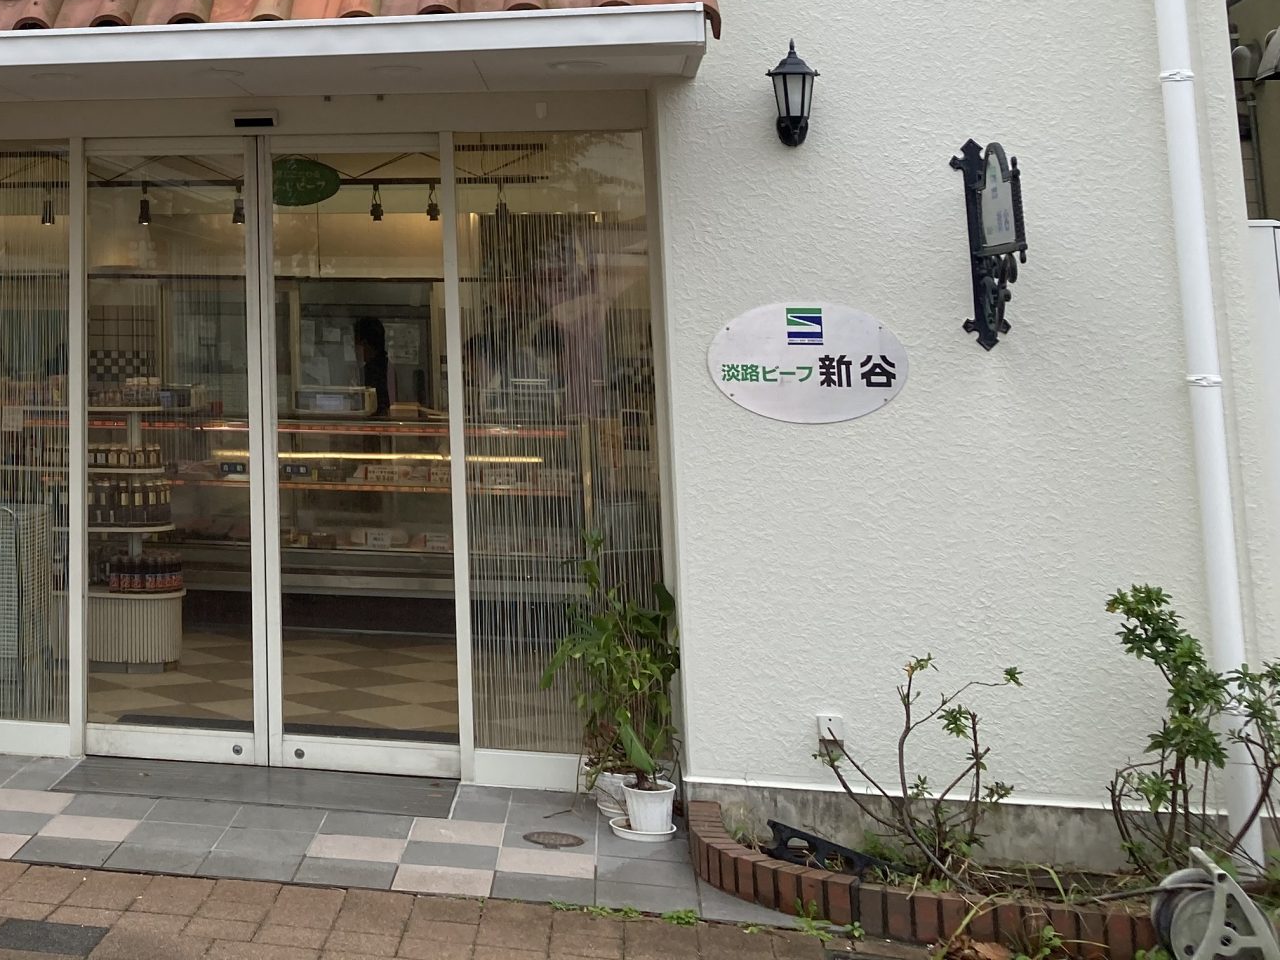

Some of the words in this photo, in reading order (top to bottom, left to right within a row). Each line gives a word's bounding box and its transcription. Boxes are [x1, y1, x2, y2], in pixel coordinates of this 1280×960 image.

[721, 363, 813, 383] 淡路ビーフ
[818, 354, 896, 388] 新谷
